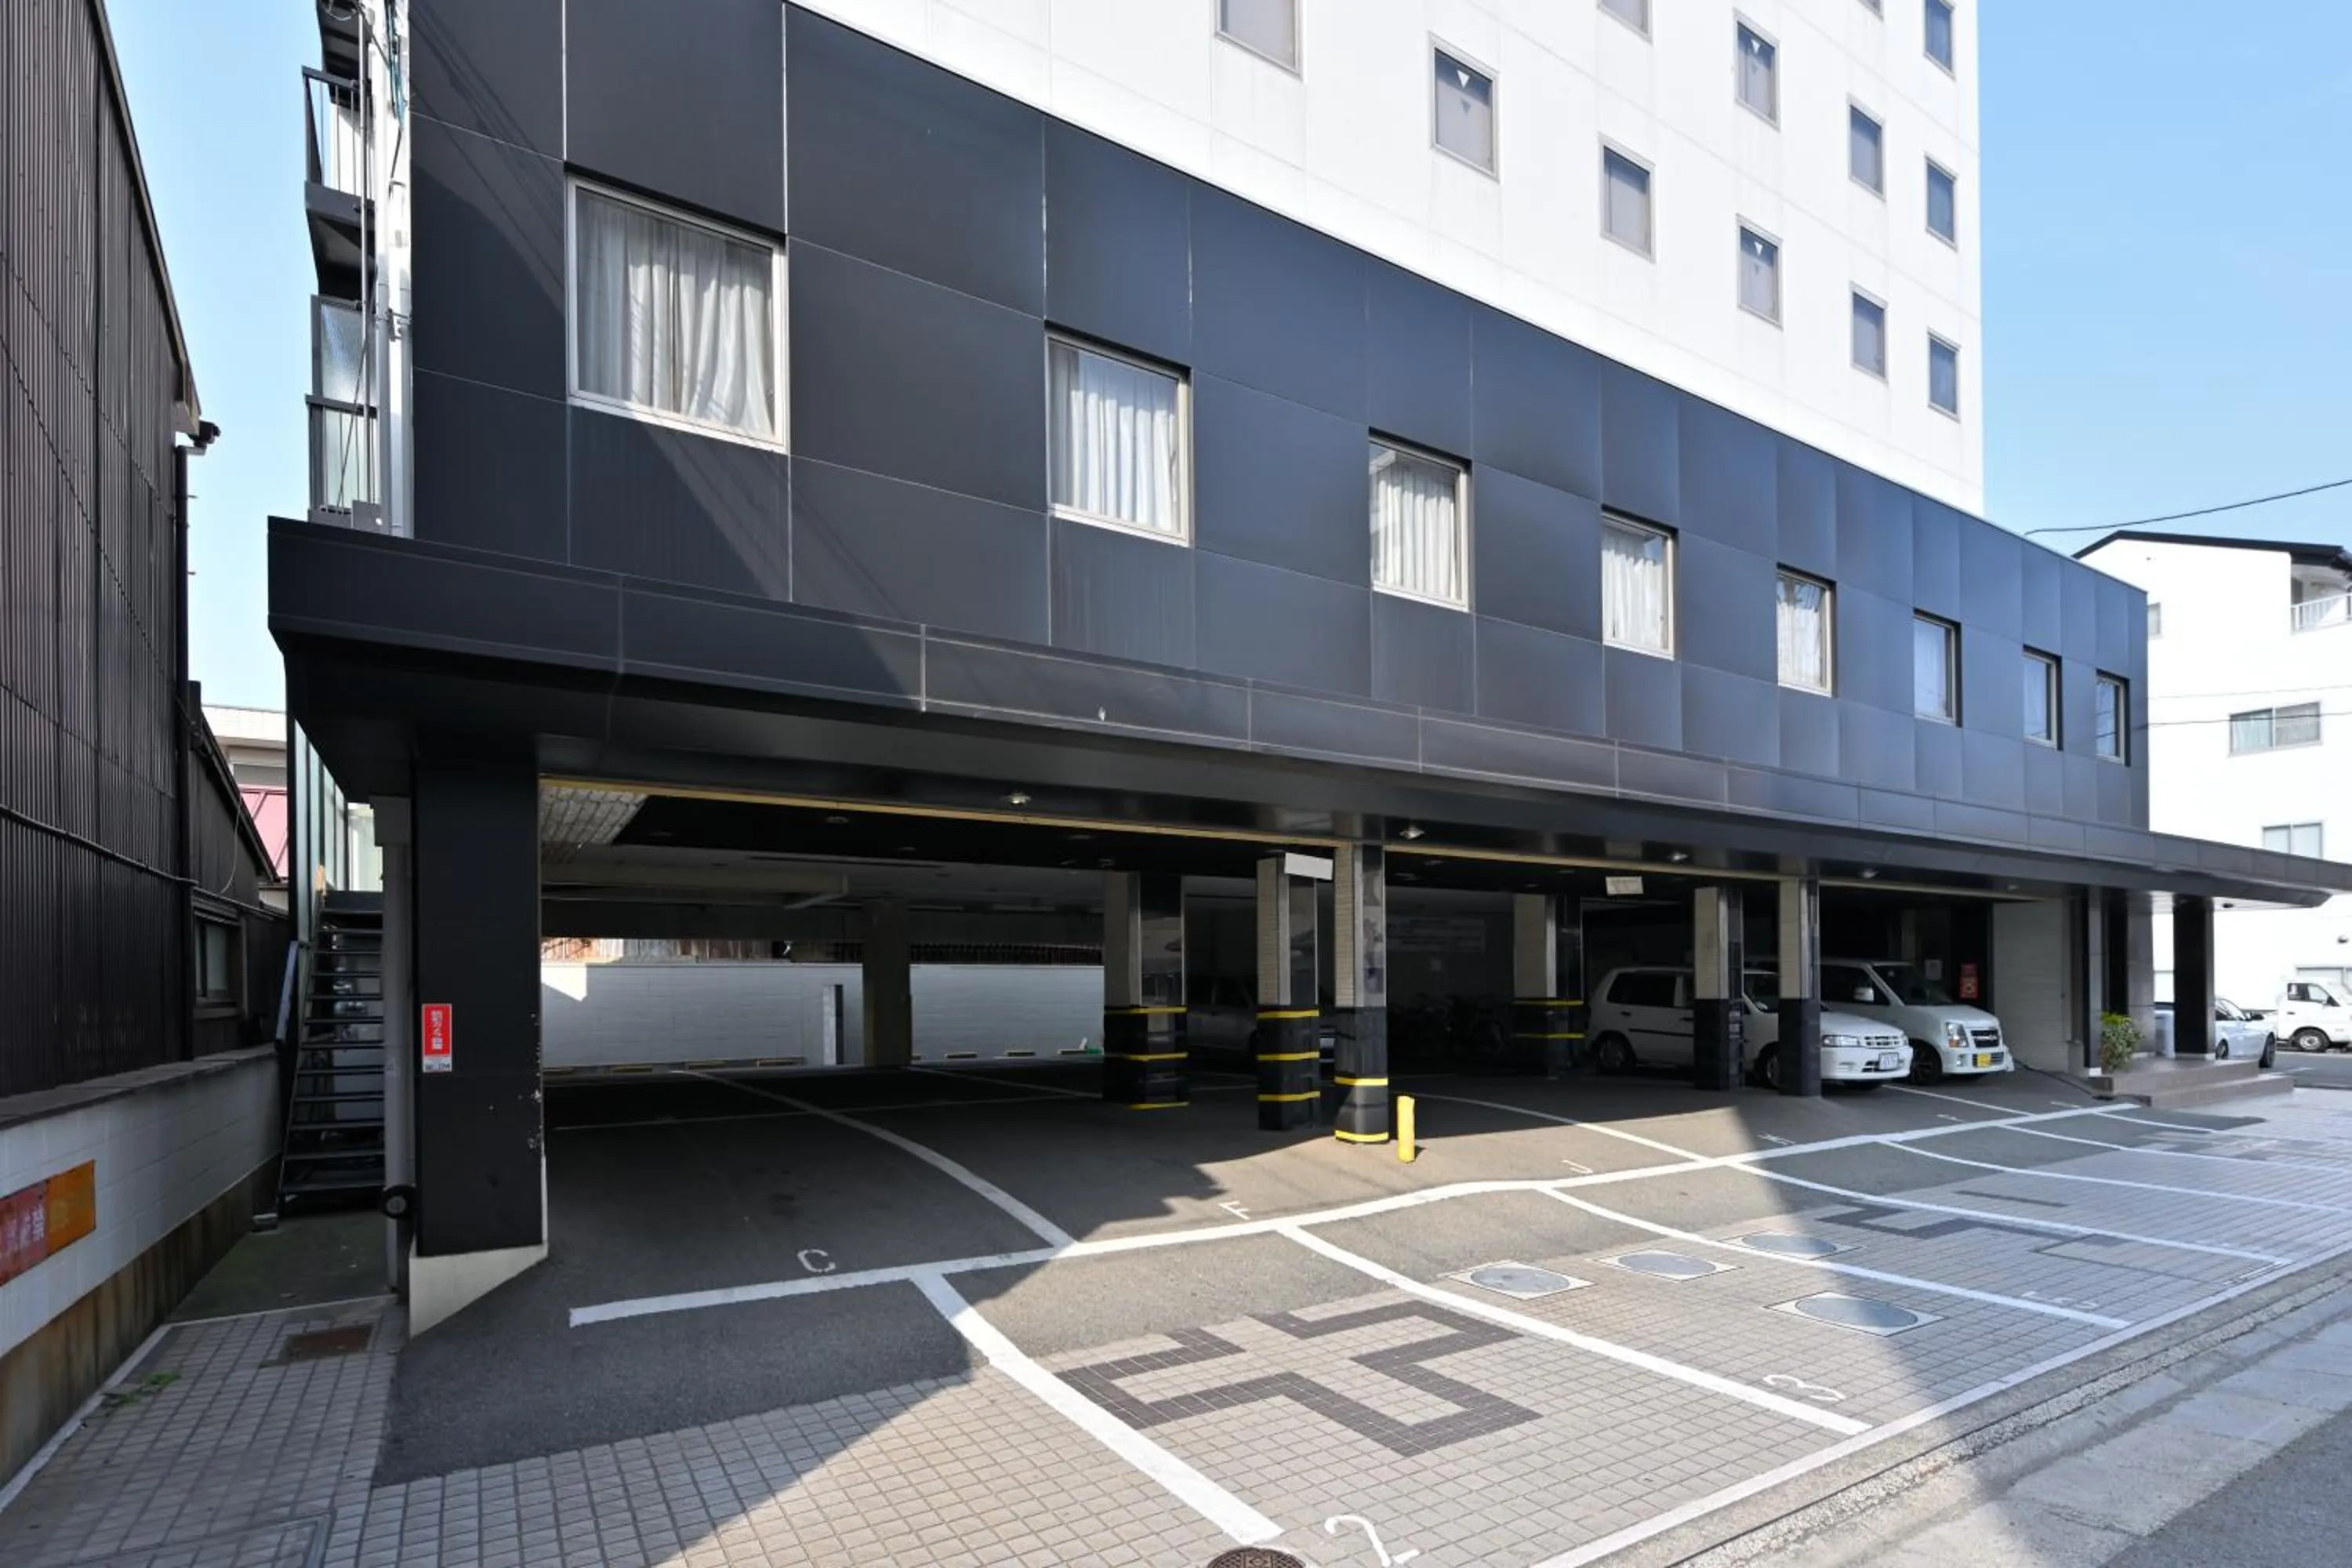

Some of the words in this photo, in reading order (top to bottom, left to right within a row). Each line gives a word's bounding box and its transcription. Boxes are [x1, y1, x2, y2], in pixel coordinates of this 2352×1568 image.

[1217, 1198, 1254, 1221] F
[796, 1248, 837, 1274] C
[1762, 1372, 1847, 1403] 3
[1323, 1513, 1421, 1568] 2
